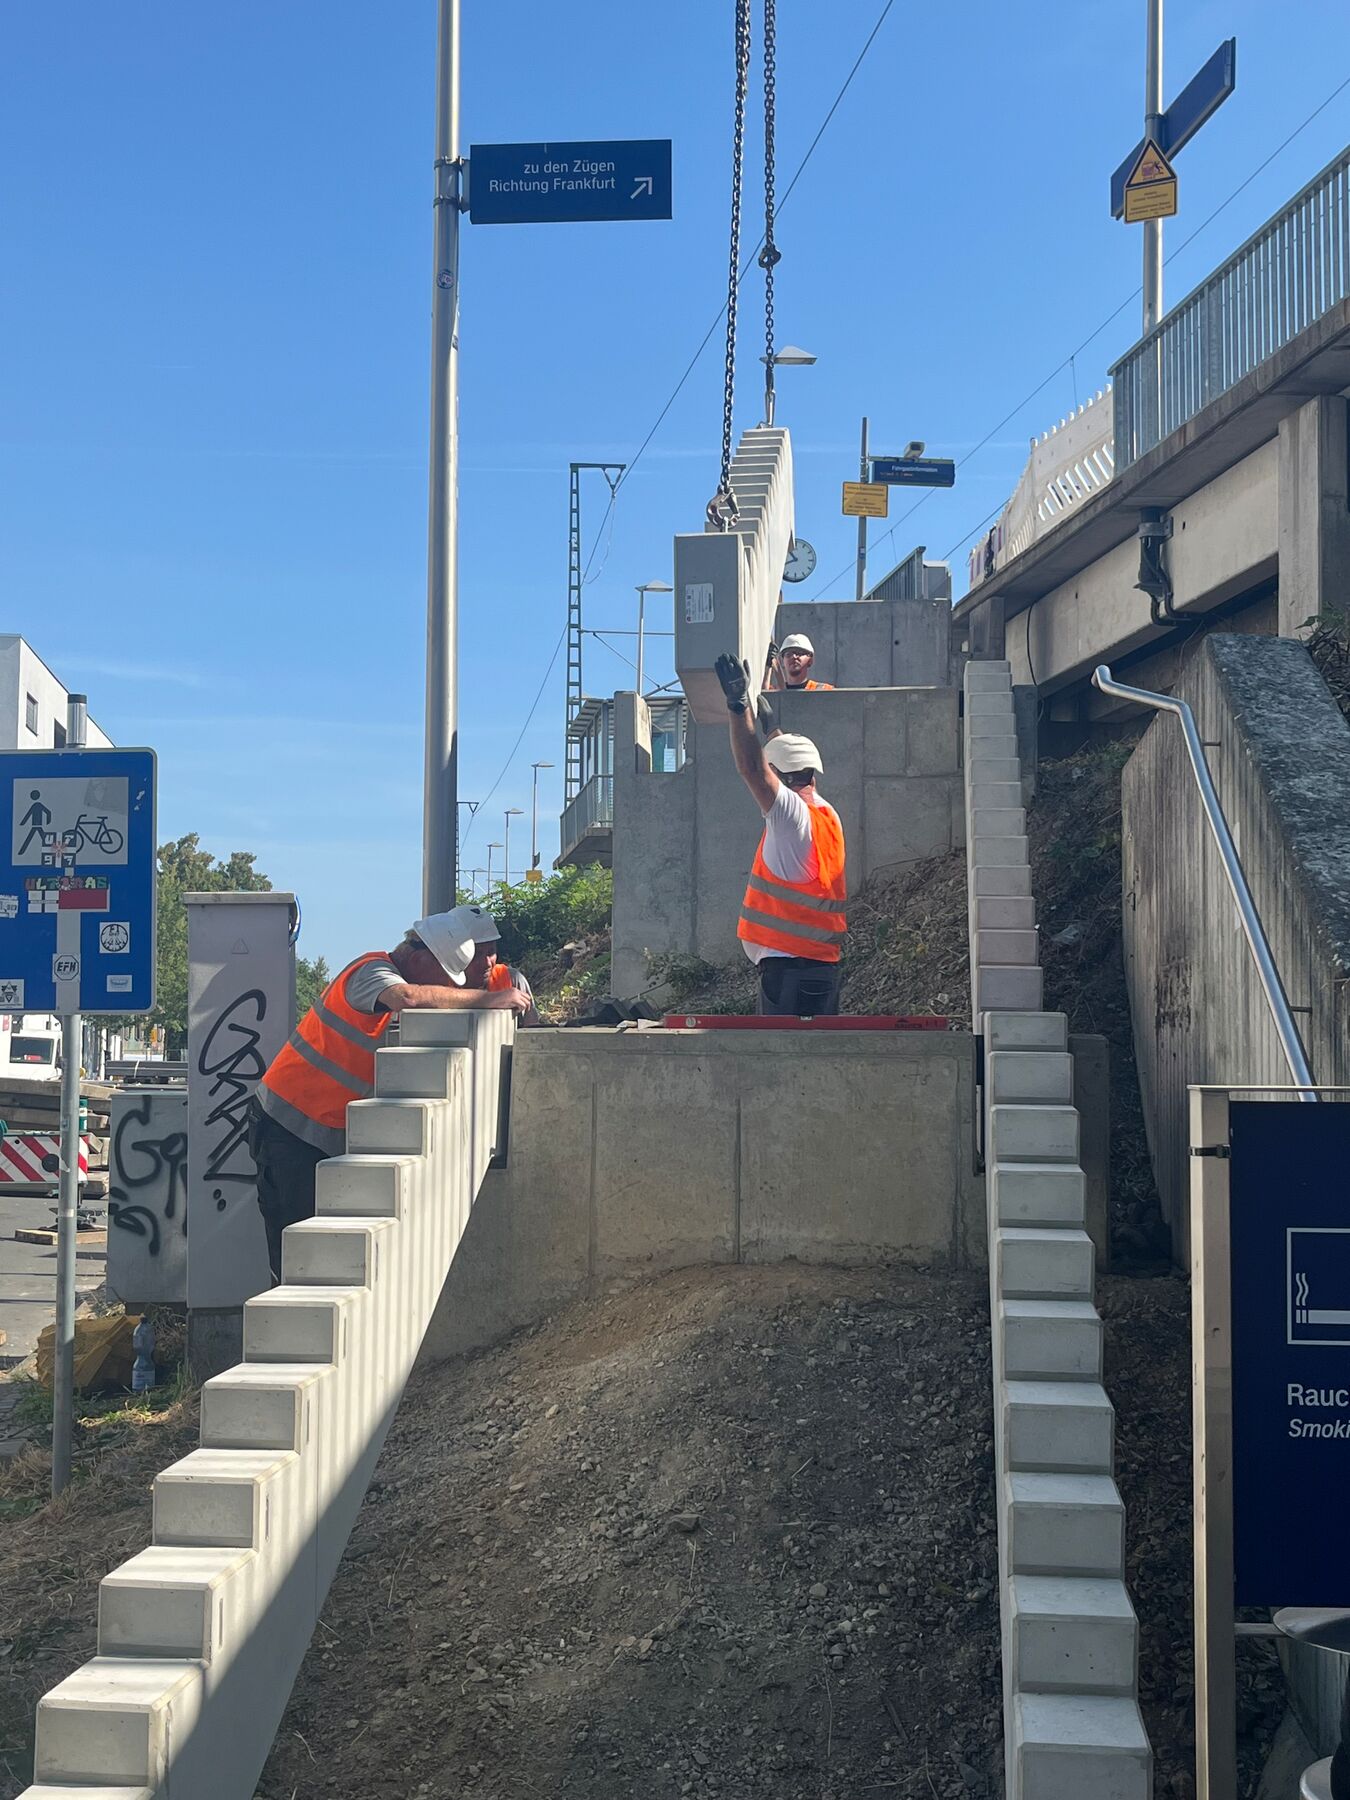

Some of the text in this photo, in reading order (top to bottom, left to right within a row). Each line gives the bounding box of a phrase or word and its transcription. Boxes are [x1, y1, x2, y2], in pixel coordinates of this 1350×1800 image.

[523, 159, 616, 175] zu den Zügen
[489, 177, 616, 194] Richtung Frankfurt
